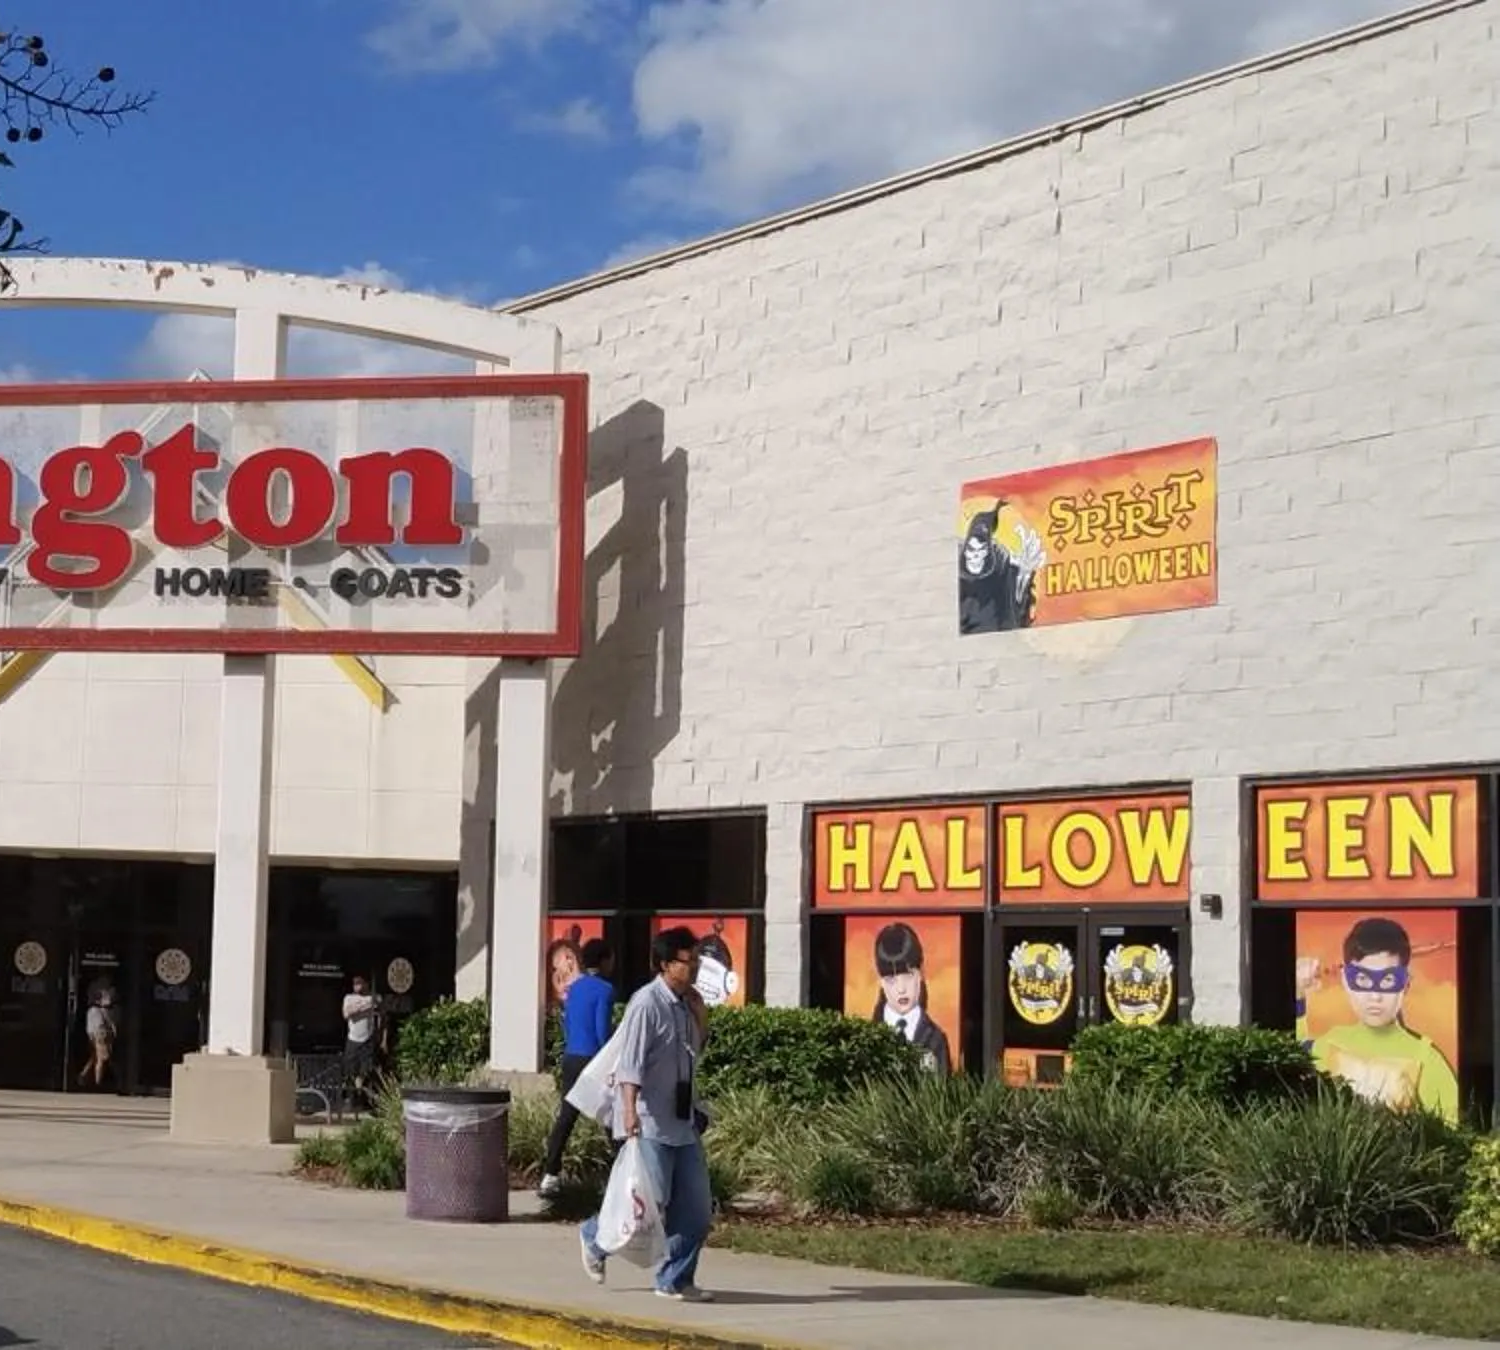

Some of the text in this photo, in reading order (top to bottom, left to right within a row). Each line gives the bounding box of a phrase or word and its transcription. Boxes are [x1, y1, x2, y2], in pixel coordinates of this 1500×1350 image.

[1047, 469, 1203, 546] SPIRIT
[154, 567, 271, 599] HOME
[328, 567, 464, 600] COATS
[1045, 541, 1212, 597] HALLOWEEN
